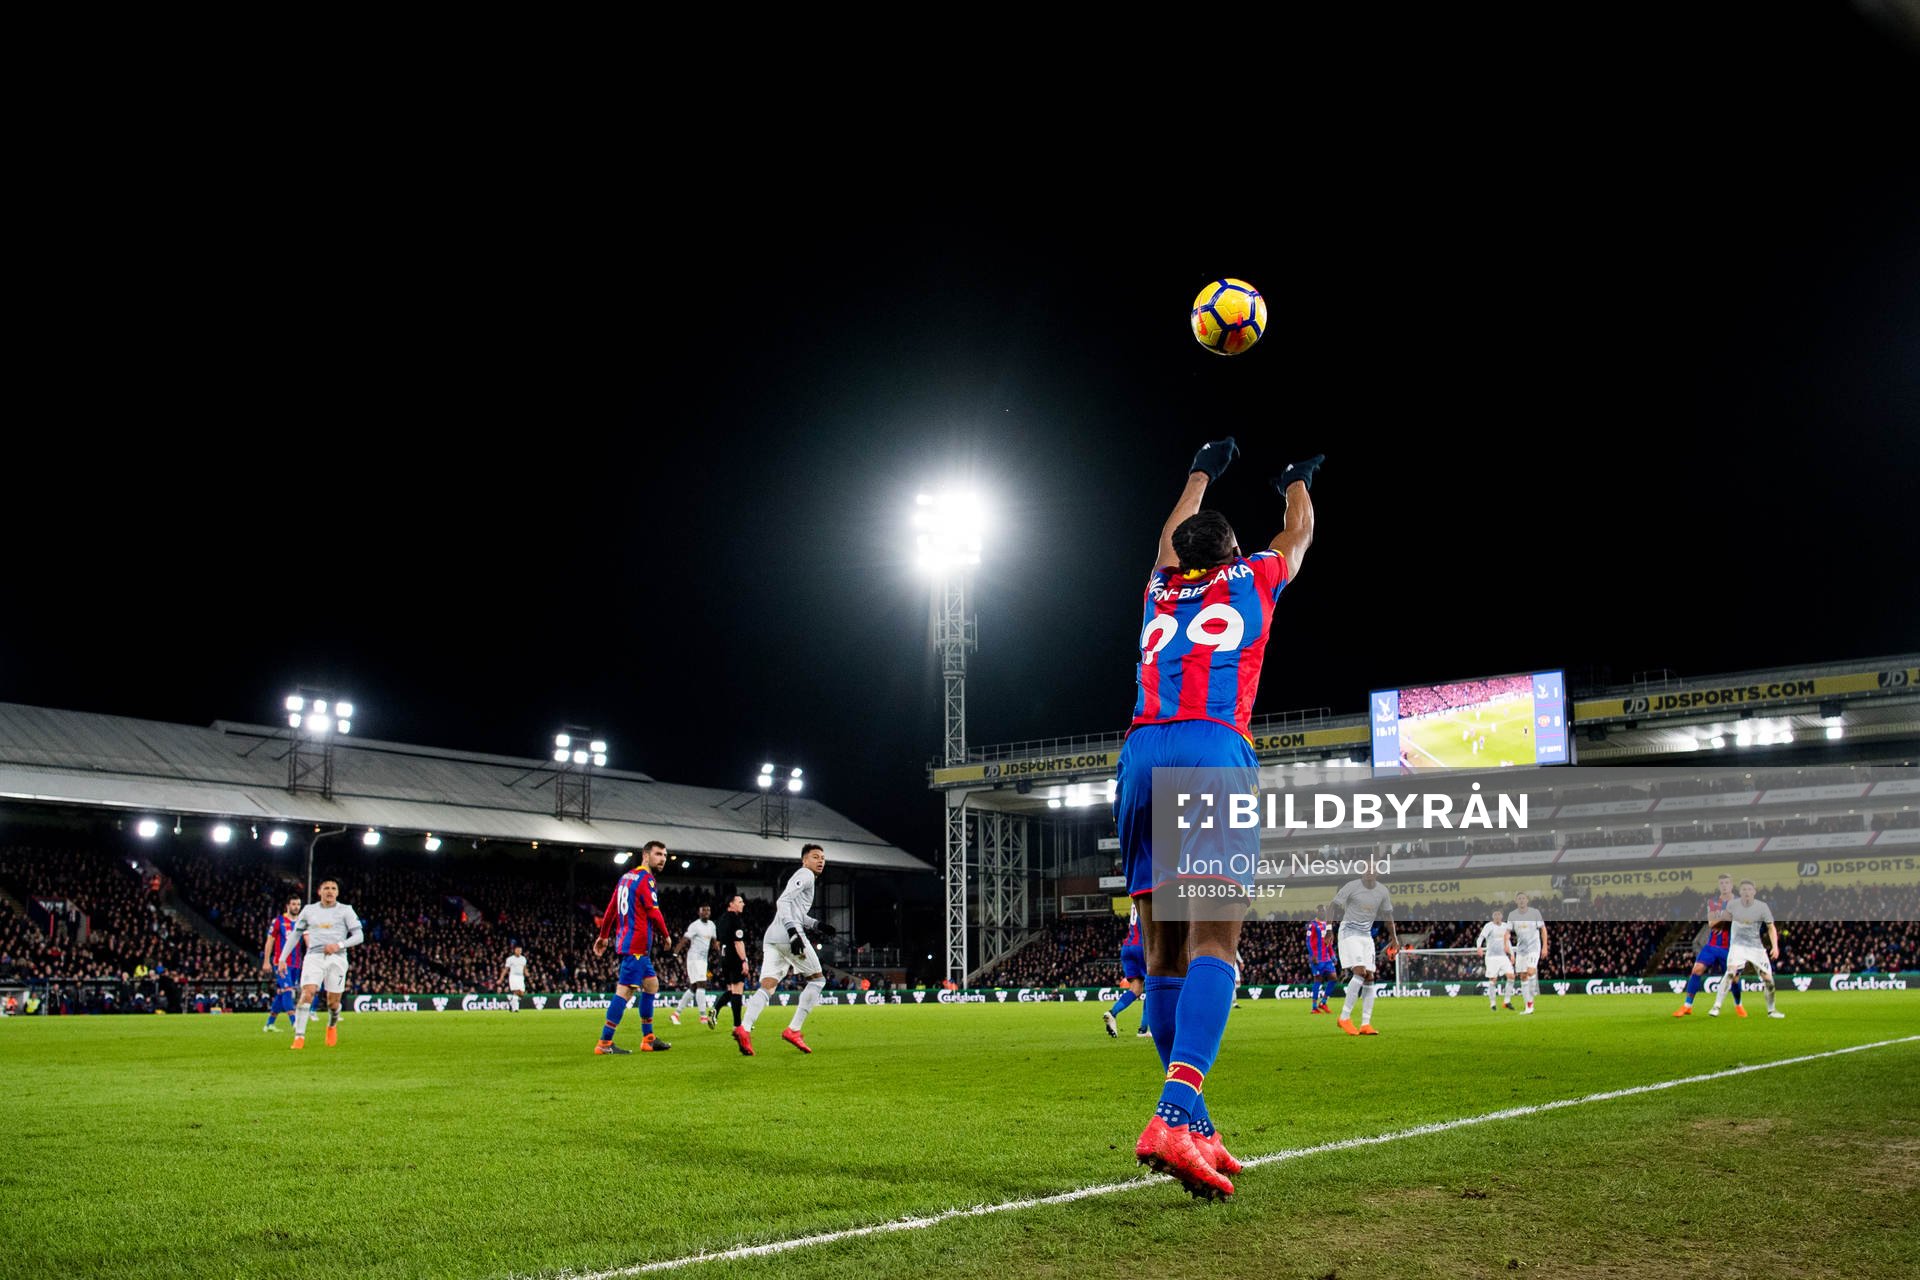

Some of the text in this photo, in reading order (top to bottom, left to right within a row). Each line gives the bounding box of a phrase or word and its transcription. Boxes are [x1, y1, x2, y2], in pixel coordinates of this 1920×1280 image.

[1626, 680, 1815, 713] JD JDSPORTS.COM
[1003, 754, 1107, 775] JDSPORTS.COM
[1800, 863, 1818, 876] JD
[1573, 870, 1693, 887] JDSPORTS.COM
[1388, 882, 1460, 895] ORTS.COM
[338, 975, 344, 986] 7
[1586, 979, 1652, 996] Carlsberg
[1830, 974, 1906, 991] Carlsberg
[354, 995, 418, 1013] Carlsberg
[462, 994, 512, 1012] Carlsber
[937, 989, 985, 1003] Carlsberg
